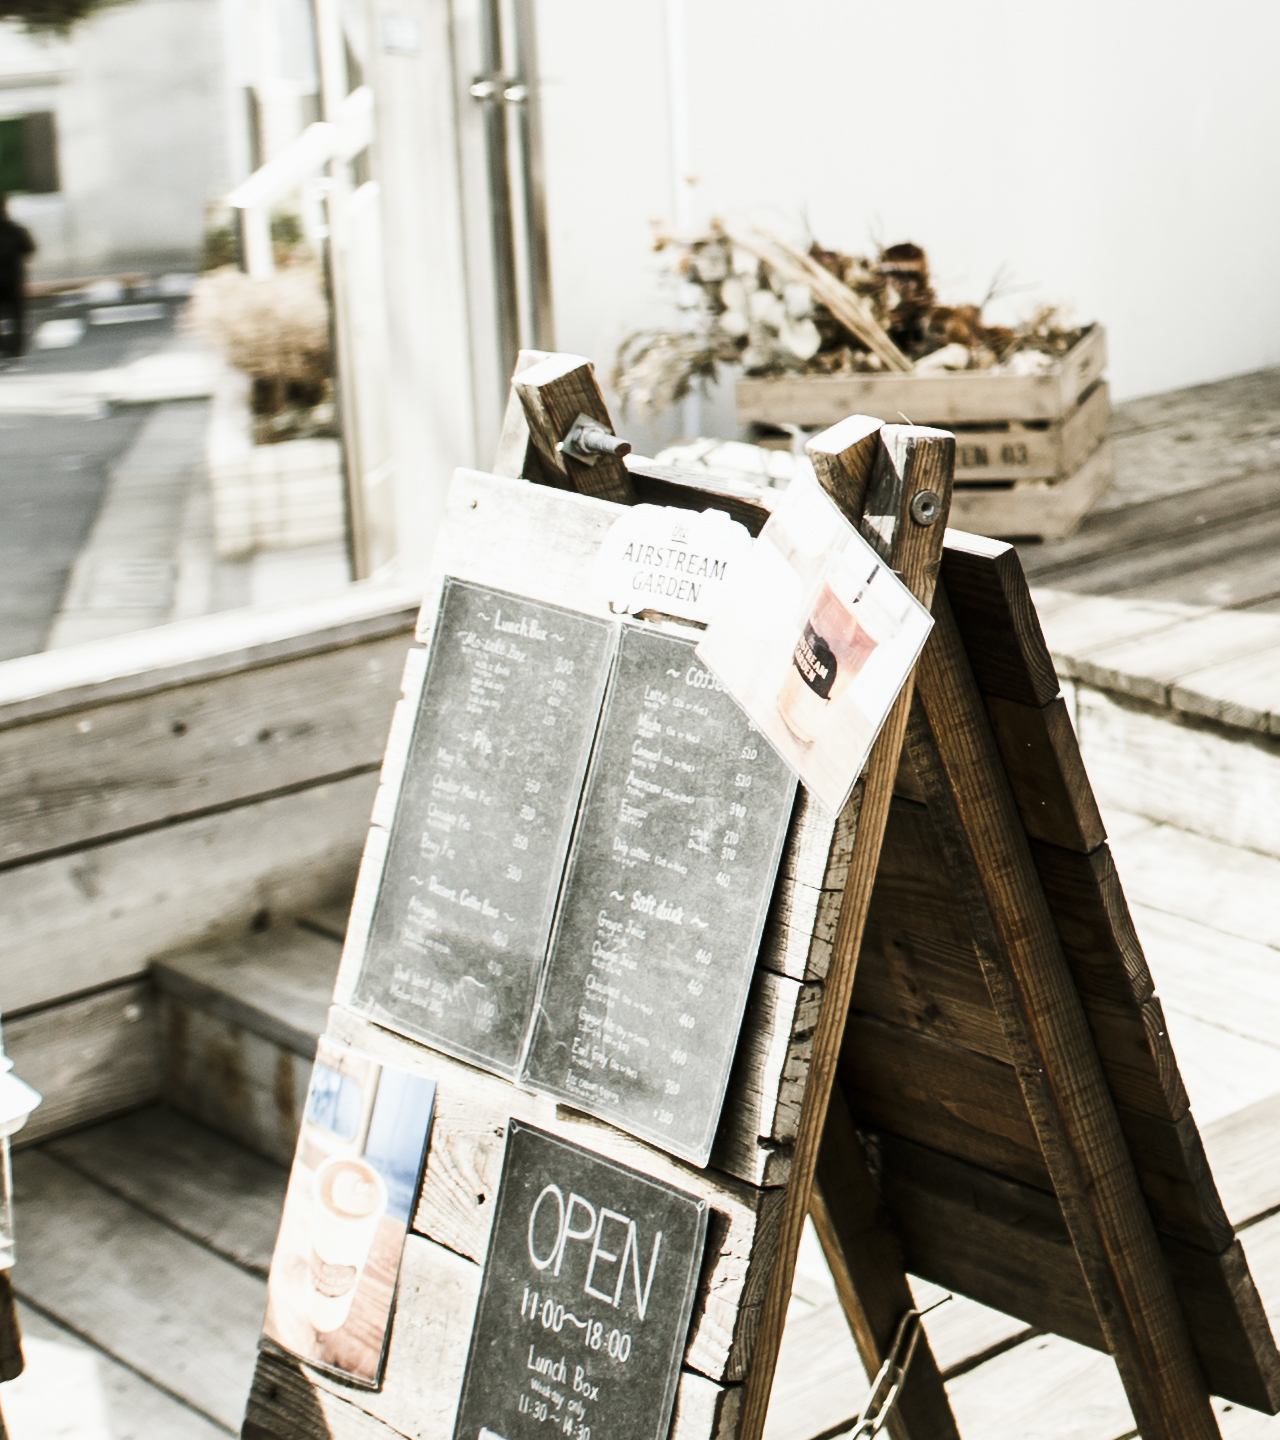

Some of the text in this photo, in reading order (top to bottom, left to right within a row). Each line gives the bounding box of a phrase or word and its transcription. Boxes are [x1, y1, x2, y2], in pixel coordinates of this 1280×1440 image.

[622, 542, 728, 581] AIRSTREAM
[632, 571, 702, 603] GARDEN
[527, 1182, 662, 1321] OPEN
[527, 1345, 598, 1400] Lunch Box
